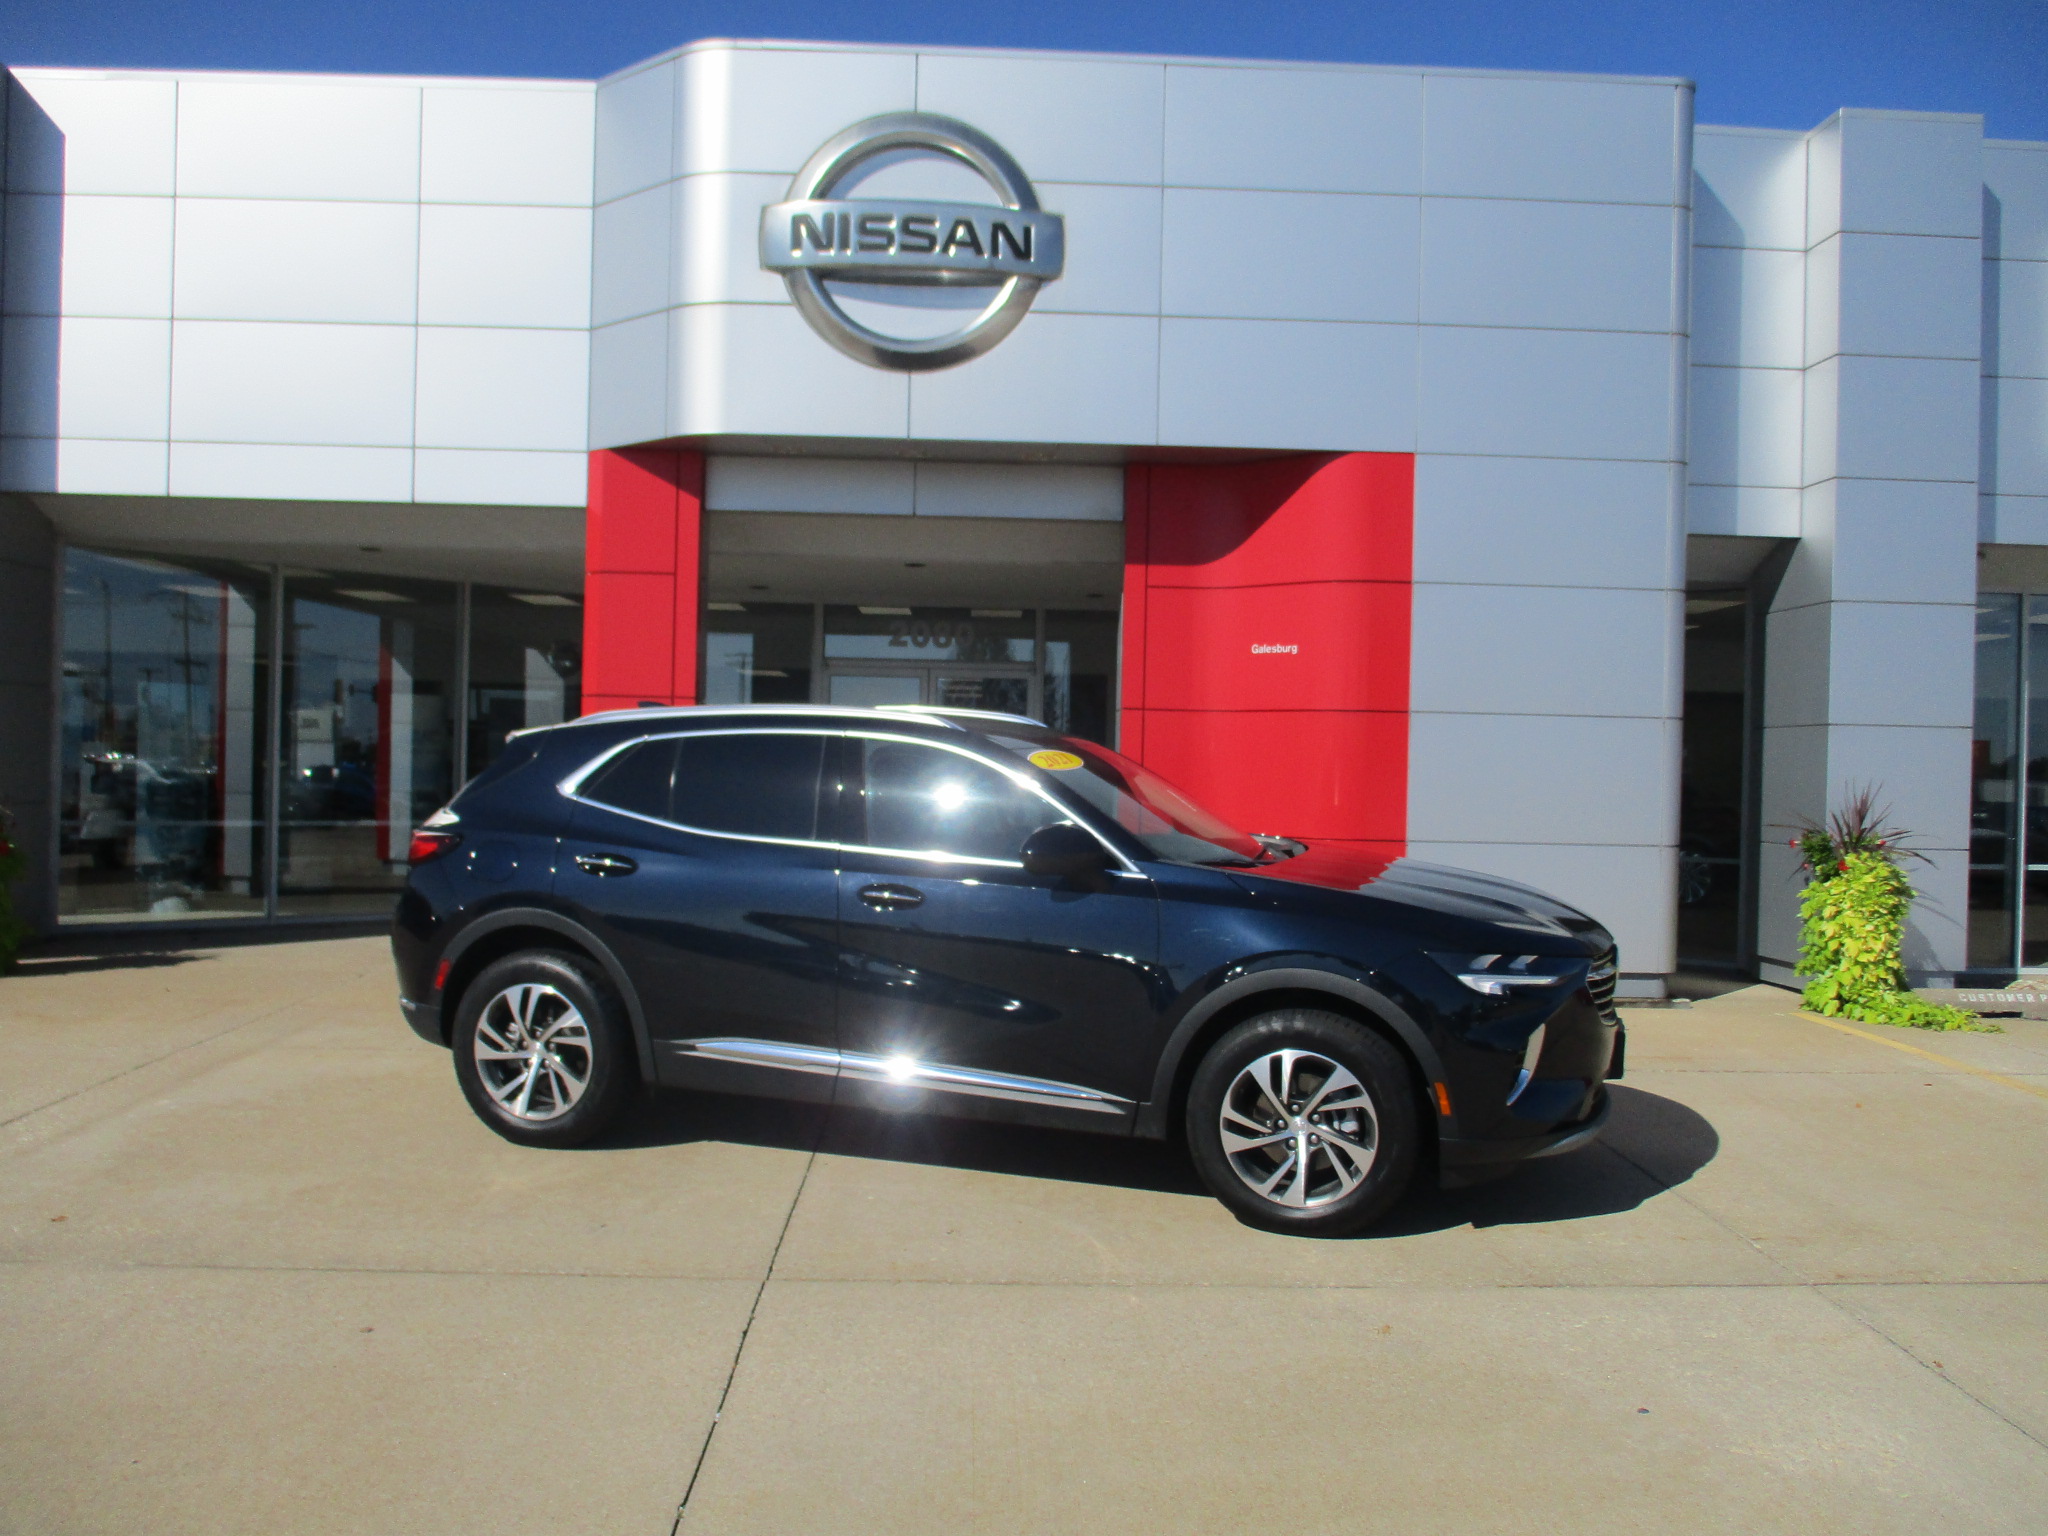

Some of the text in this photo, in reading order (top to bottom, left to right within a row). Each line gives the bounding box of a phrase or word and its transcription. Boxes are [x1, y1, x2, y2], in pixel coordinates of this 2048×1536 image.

[790, 211, 1036, 263] NISSAN
[1250, 643, 1299, 655] Galesburg
[1959, 993, 2036, 1003] CUSTOMER
